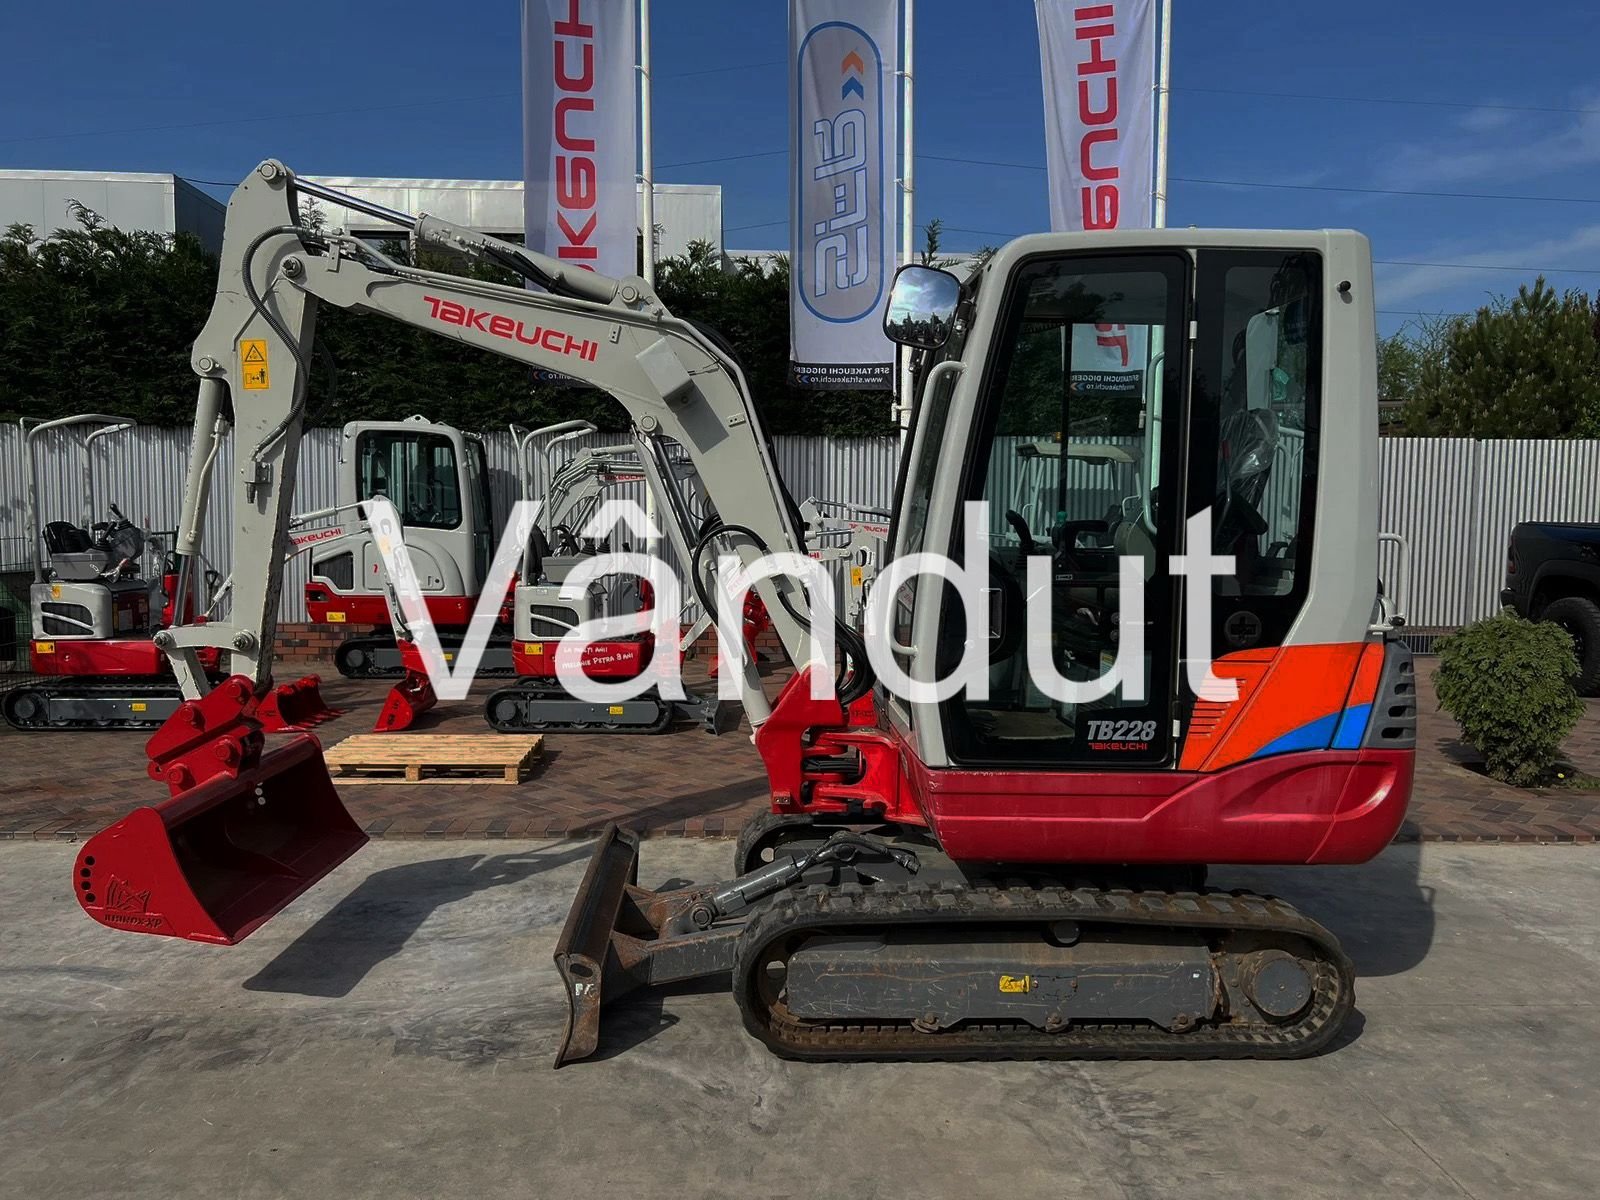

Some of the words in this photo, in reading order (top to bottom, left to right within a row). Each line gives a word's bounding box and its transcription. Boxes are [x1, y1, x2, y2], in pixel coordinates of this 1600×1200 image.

[423, 295, 599, 362] TAKEUCHI
[592, 655, 615, 665] PETRA
[623, 652, 634, 660] ANI
[1087, 719, 1157, 741] TB228
[1088, 742, 1148, 750] TAKEUCHI
